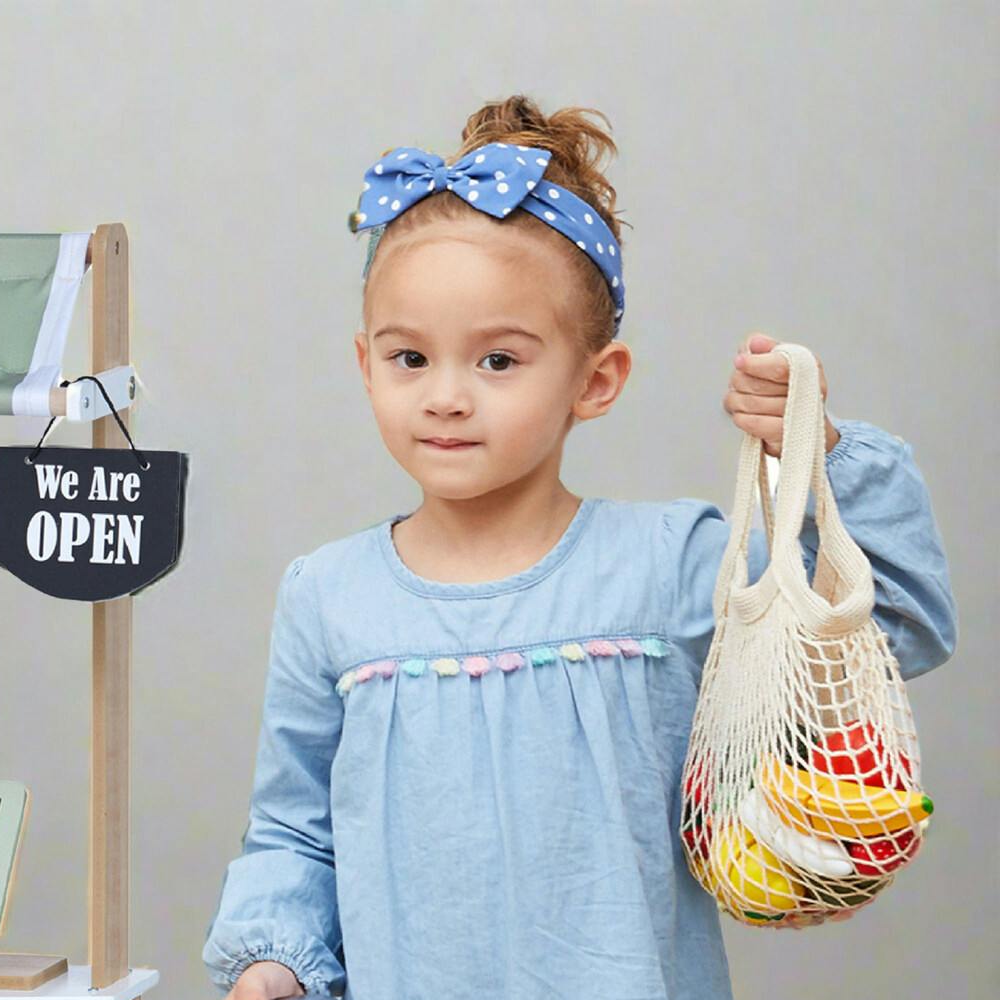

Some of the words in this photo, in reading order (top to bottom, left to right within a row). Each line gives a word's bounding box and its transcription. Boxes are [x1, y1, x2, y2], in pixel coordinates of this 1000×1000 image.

[34, 464, 79, 500] We
[88, 466, 141, 502] Are
[26, 510, 145, 565] OPEN
